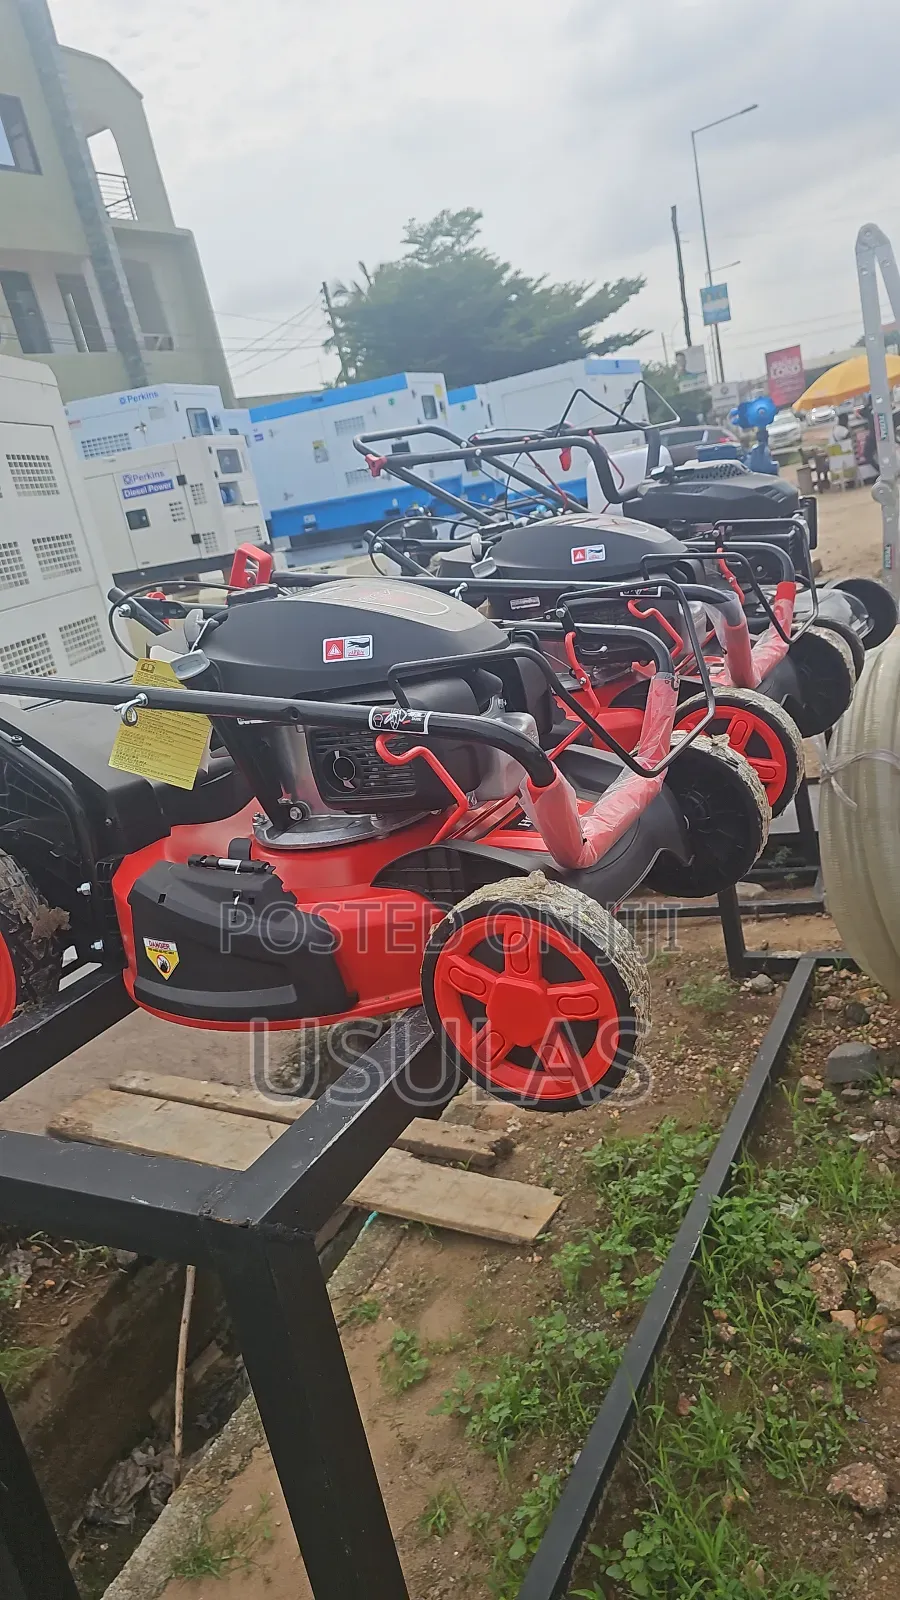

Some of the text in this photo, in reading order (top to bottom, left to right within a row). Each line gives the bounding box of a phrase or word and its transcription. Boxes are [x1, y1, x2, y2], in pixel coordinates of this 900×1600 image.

[127, 391, 159, 404] Perkins
[133, 471, 165, 483] Perkins
[124, 481, 172, 498] Diesel Power
[148, 940, 170, 950] DANGER
